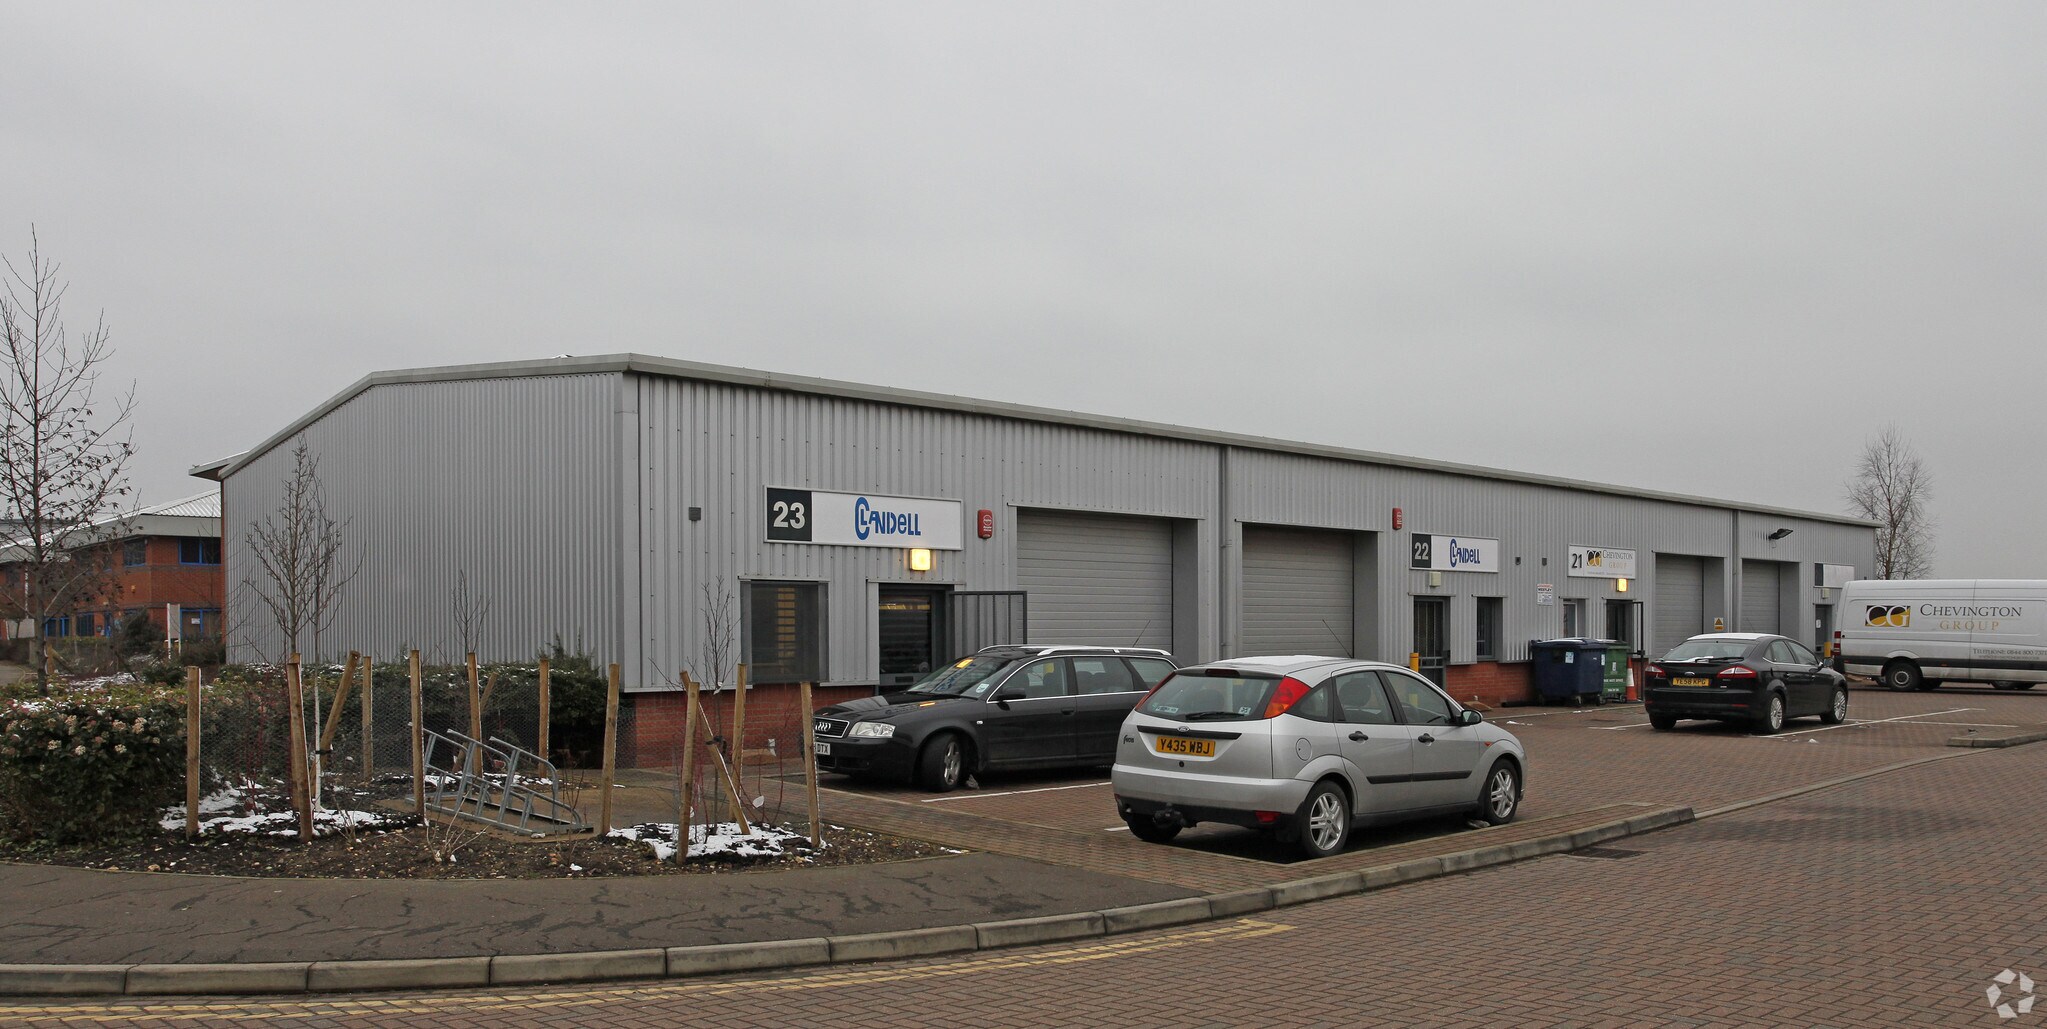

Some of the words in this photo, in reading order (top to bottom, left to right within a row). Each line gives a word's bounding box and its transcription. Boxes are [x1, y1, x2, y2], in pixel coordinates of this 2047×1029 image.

[772, 500, 806, 529] 23
[1414, 542, 1429, 560] 22
[1571, 553, 1582, 568] 21
[1866, 605, 1909, 627] CG
[1920, 603, 2022, 617] CHEVINGTON
[1940, 620, 1999, 631] GROUP
[1160, 738, 1187, 752] Y435
[1189, 741, 1210, 754] WBJ
